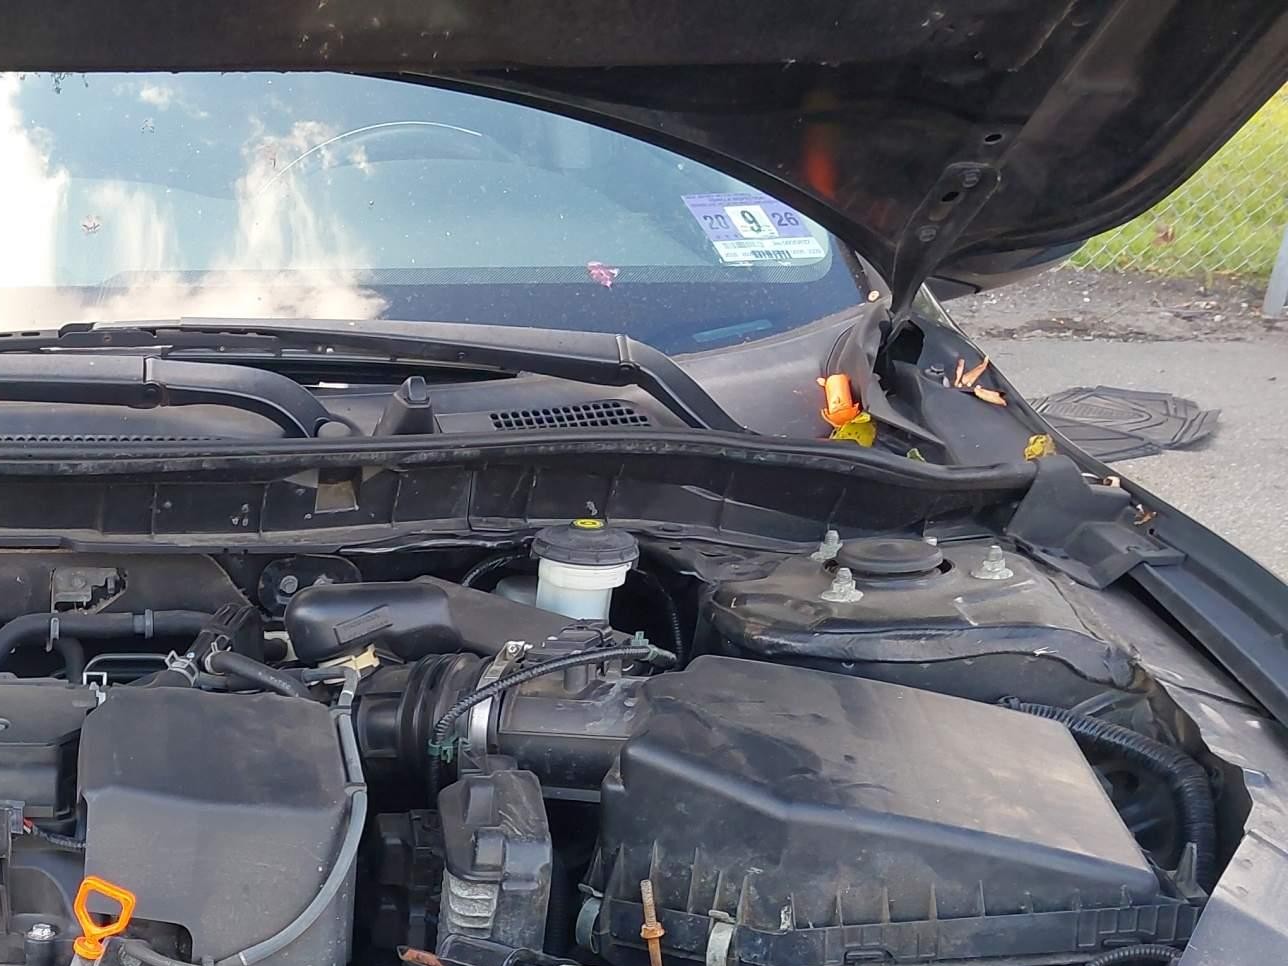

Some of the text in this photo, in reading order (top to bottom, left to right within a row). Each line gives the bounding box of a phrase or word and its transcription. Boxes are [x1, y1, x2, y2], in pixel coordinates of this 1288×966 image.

[703, 210, 800, 233] 20 9 26
